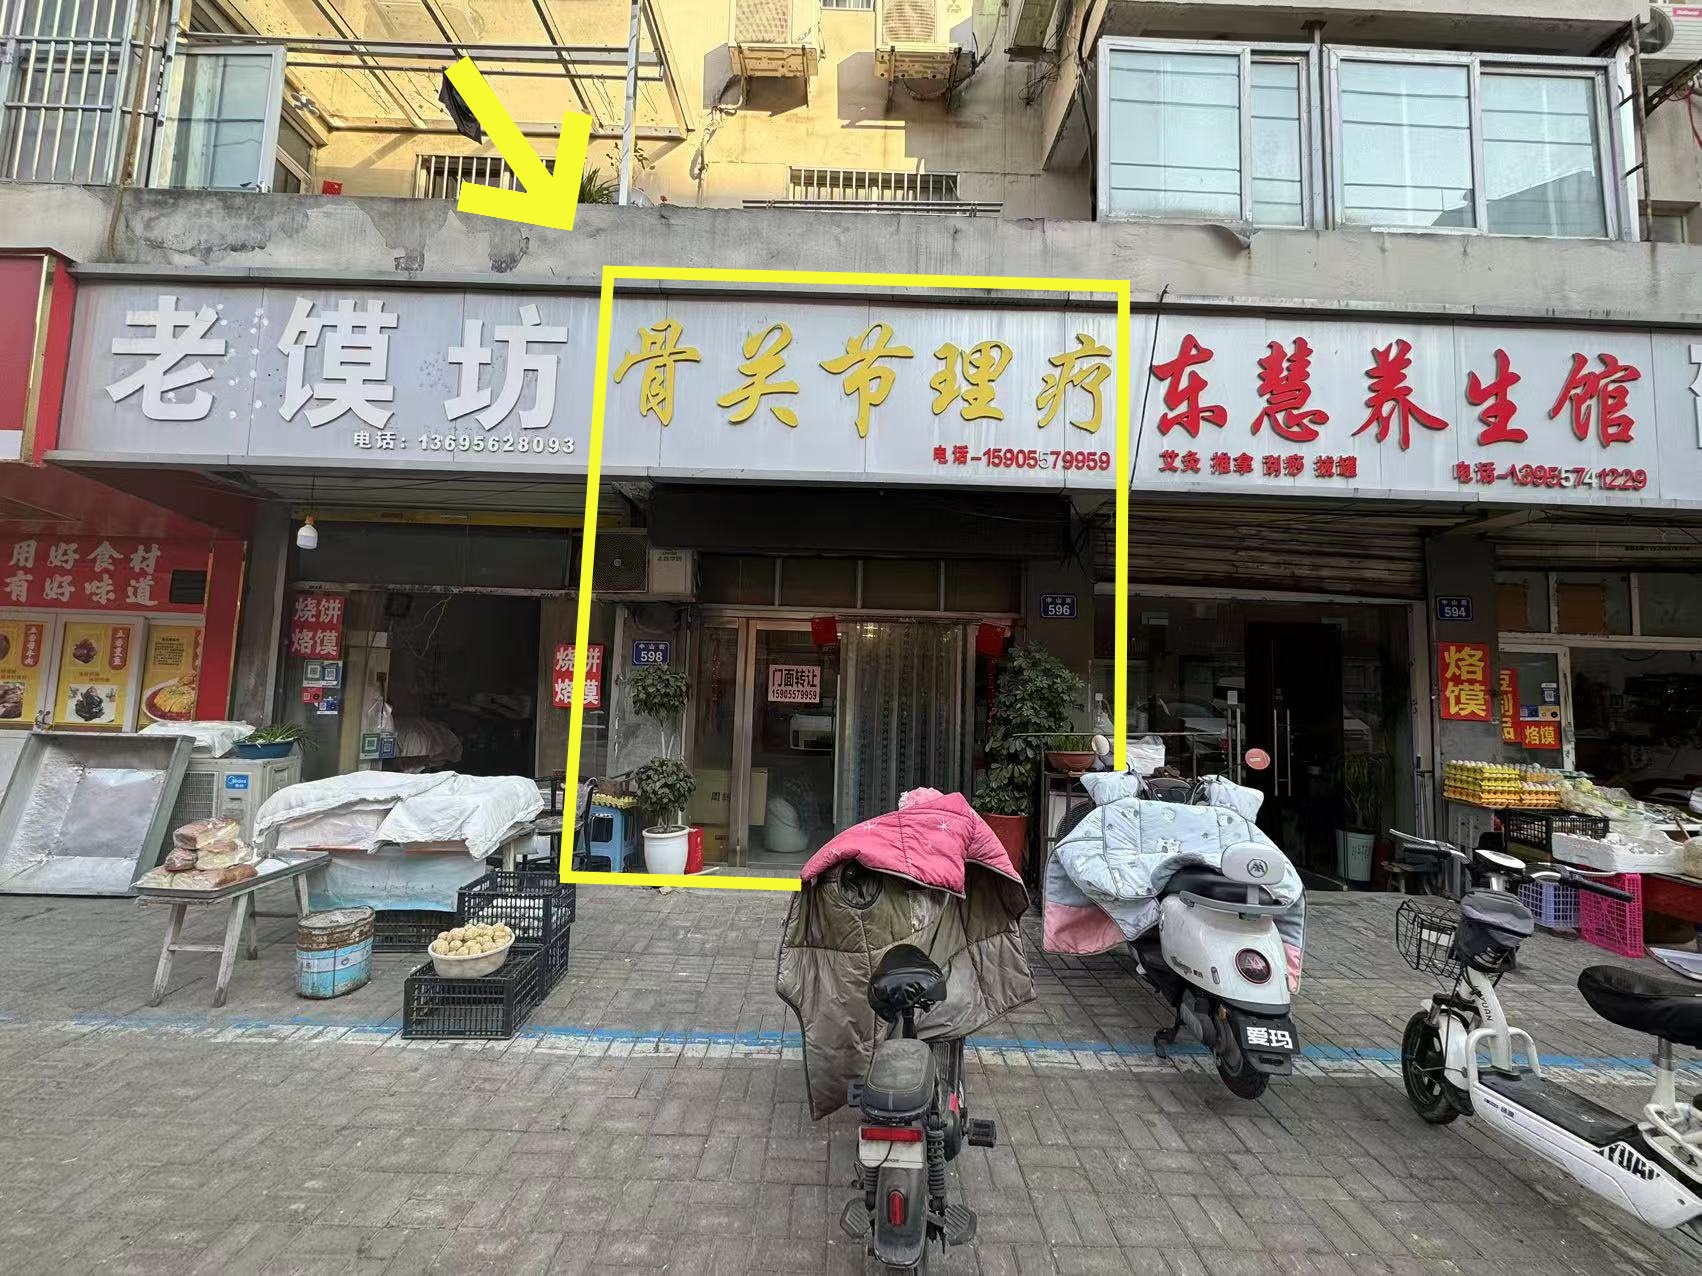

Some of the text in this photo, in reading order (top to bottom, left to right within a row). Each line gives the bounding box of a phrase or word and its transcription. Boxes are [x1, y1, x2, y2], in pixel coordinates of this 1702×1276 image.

[104, 294, 568, 430] 老馍坊
[613, 318, 1112, 438] 骨关节理疗
[1151, 333, 1641, 450] 东慧养生馆
[1159, 449, 1357, 479] 艾灸 推拿 刮痧 拔罐
[8, 538, 161, 574] 用好食材
[4, 570, 159, 606] 有好味道
[294, 596, 341, 624] 烧饼
[1048, 604, 1071, 615] 596
[1444, 606, 1466, 617] 594
[291, 628, 339, 656] 烙馍
[640, 650, 663, 662] 598
[772, 667, 817, 688] 门面转让
[1444, 645, 1487, 718] 烙馍
[772, 688, 817, 700] 15905579959
[1525, 725, 1556, 745] 烙馍
[1246, 1026, 1294, 1050] 爱玛
